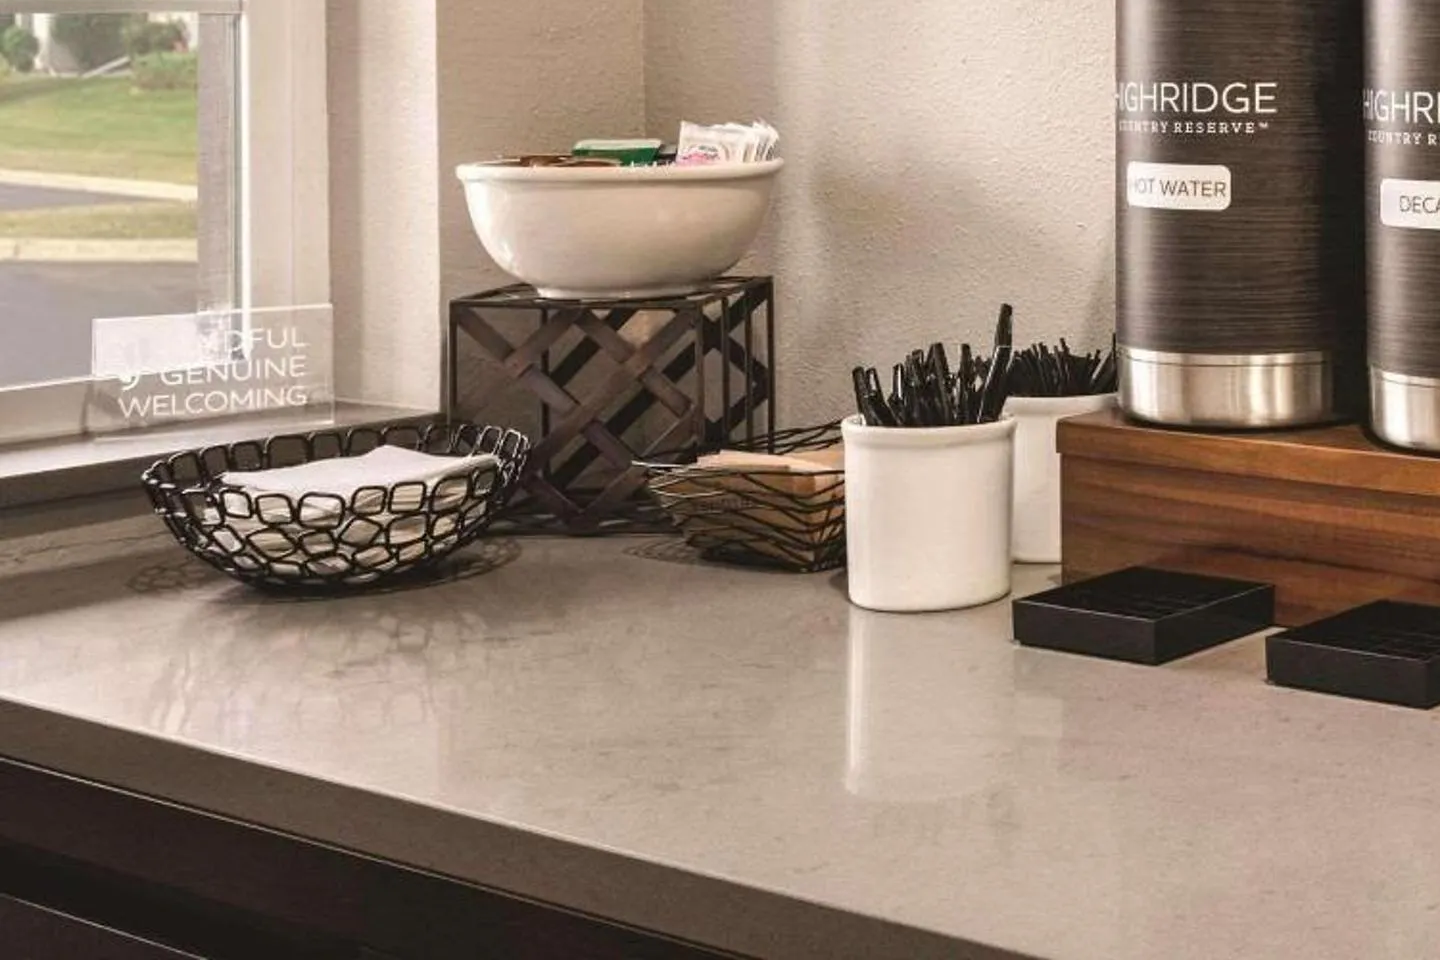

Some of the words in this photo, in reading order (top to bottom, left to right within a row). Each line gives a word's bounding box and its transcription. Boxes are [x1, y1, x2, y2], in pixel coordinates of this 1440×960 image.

[1115, 81, 1278, 114] IGHRIDGE
[1159, 178, 1228, 198] WATER
[160, 355, 307, 386] GENUINE
[118, 385, 308, 419] WELCOMING
